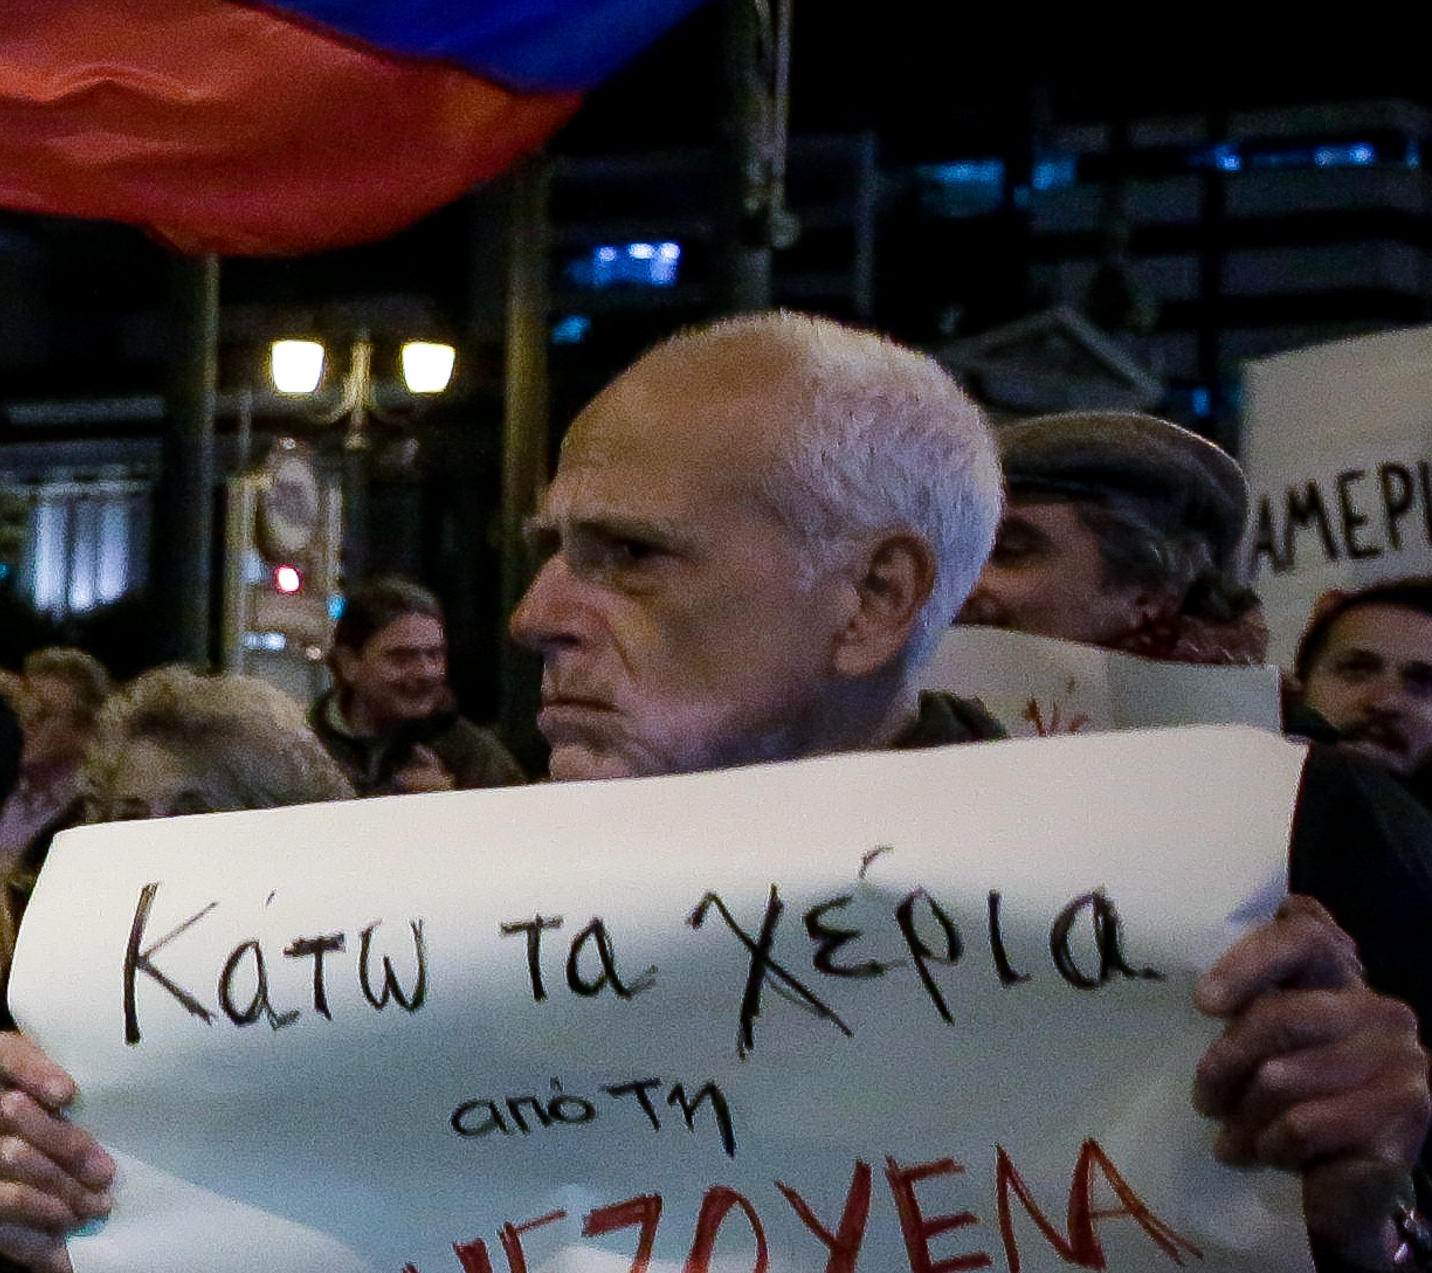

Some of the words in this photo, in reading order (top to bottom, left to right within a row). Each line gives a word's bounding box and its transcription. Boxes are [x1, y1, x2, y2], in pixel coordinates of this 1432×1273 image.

[122, 881, 428, 1046] Κάτω
[503, 911, 658, 1003] τα
[449, 1074, 594, 1139] από
